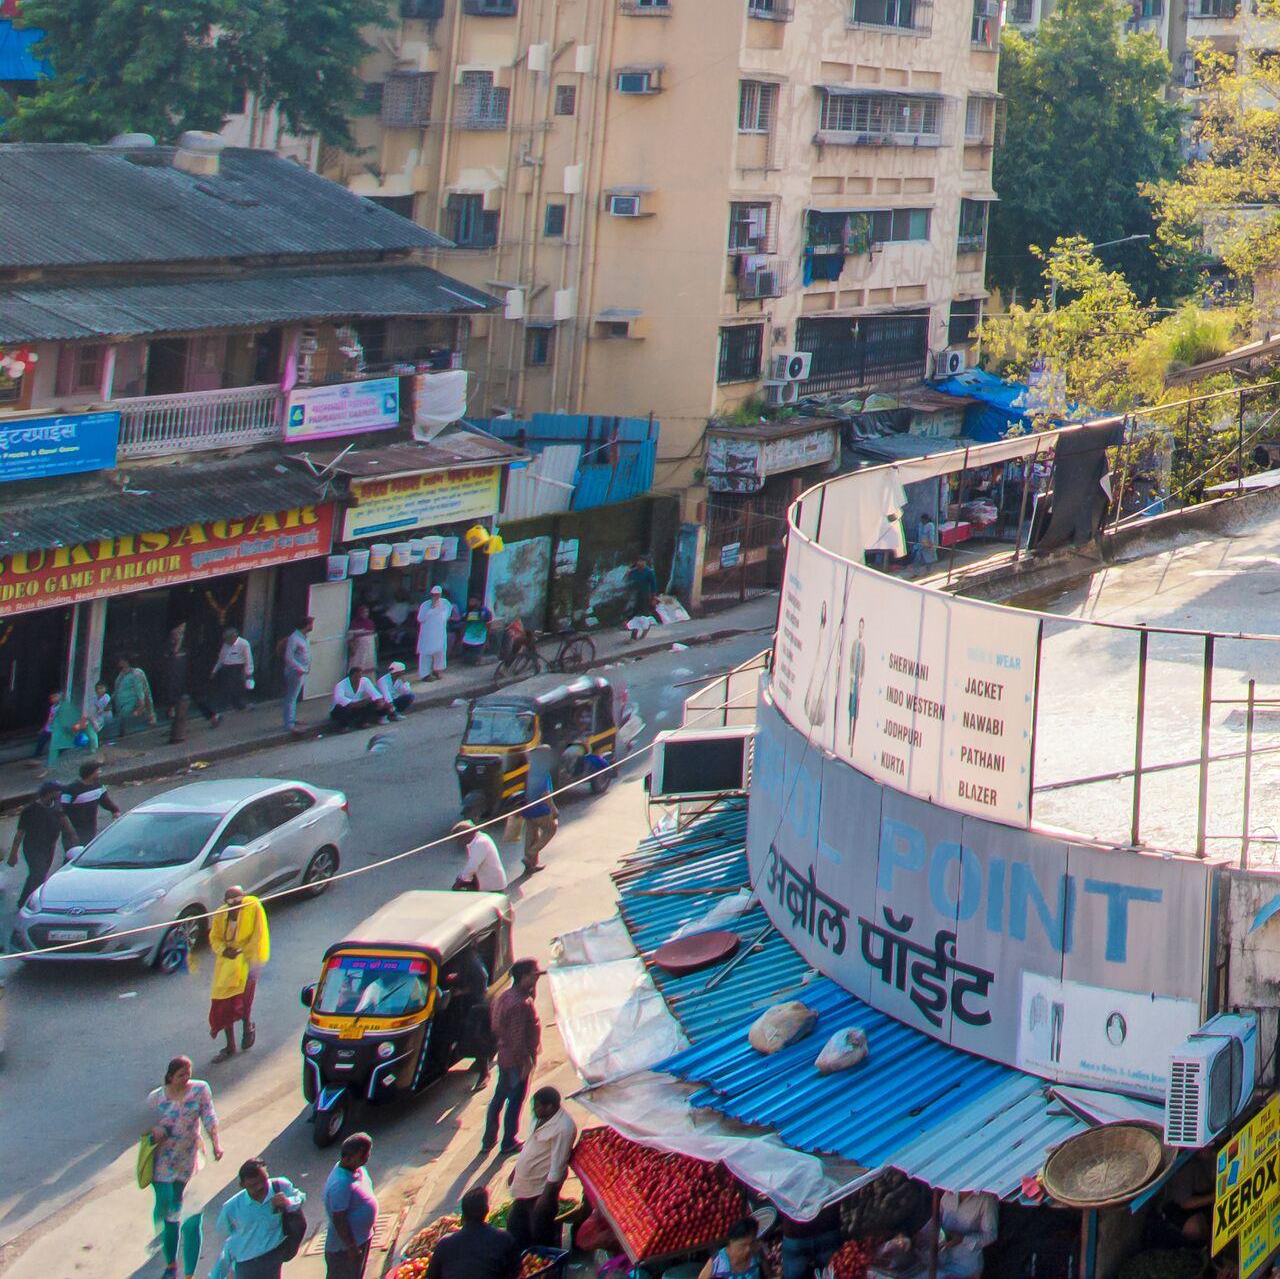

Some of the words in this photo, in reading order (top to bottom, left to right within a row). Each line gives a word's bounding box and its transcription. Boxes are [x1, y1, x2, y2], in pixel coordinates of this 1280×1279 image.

[44, 570, 95, 593] GAME
[100, 554, 181, 583] PARLOUR
[75, 589, 94, 602] Near
[889, 652, 929, 682] SHERWANI
[995, 654, 1021, 671] WEAR
[965, 677, 1004, 702] JACKET
[886, 686, 905, 707] INDO
[906, 692, 945, 721] WESTERN
[883, 722, 922, 748] JODHPURI
[963, 711, 1004, 737] NAWABI
[880, 752, 905, 777] KURTA
[960, 745, 1005, 772] PATHANI
[958, 780, 997, 807] BLAZER
[878, 817, 1164, 963] POINT
[1216, 1155, 1278, 1238] XEROX
